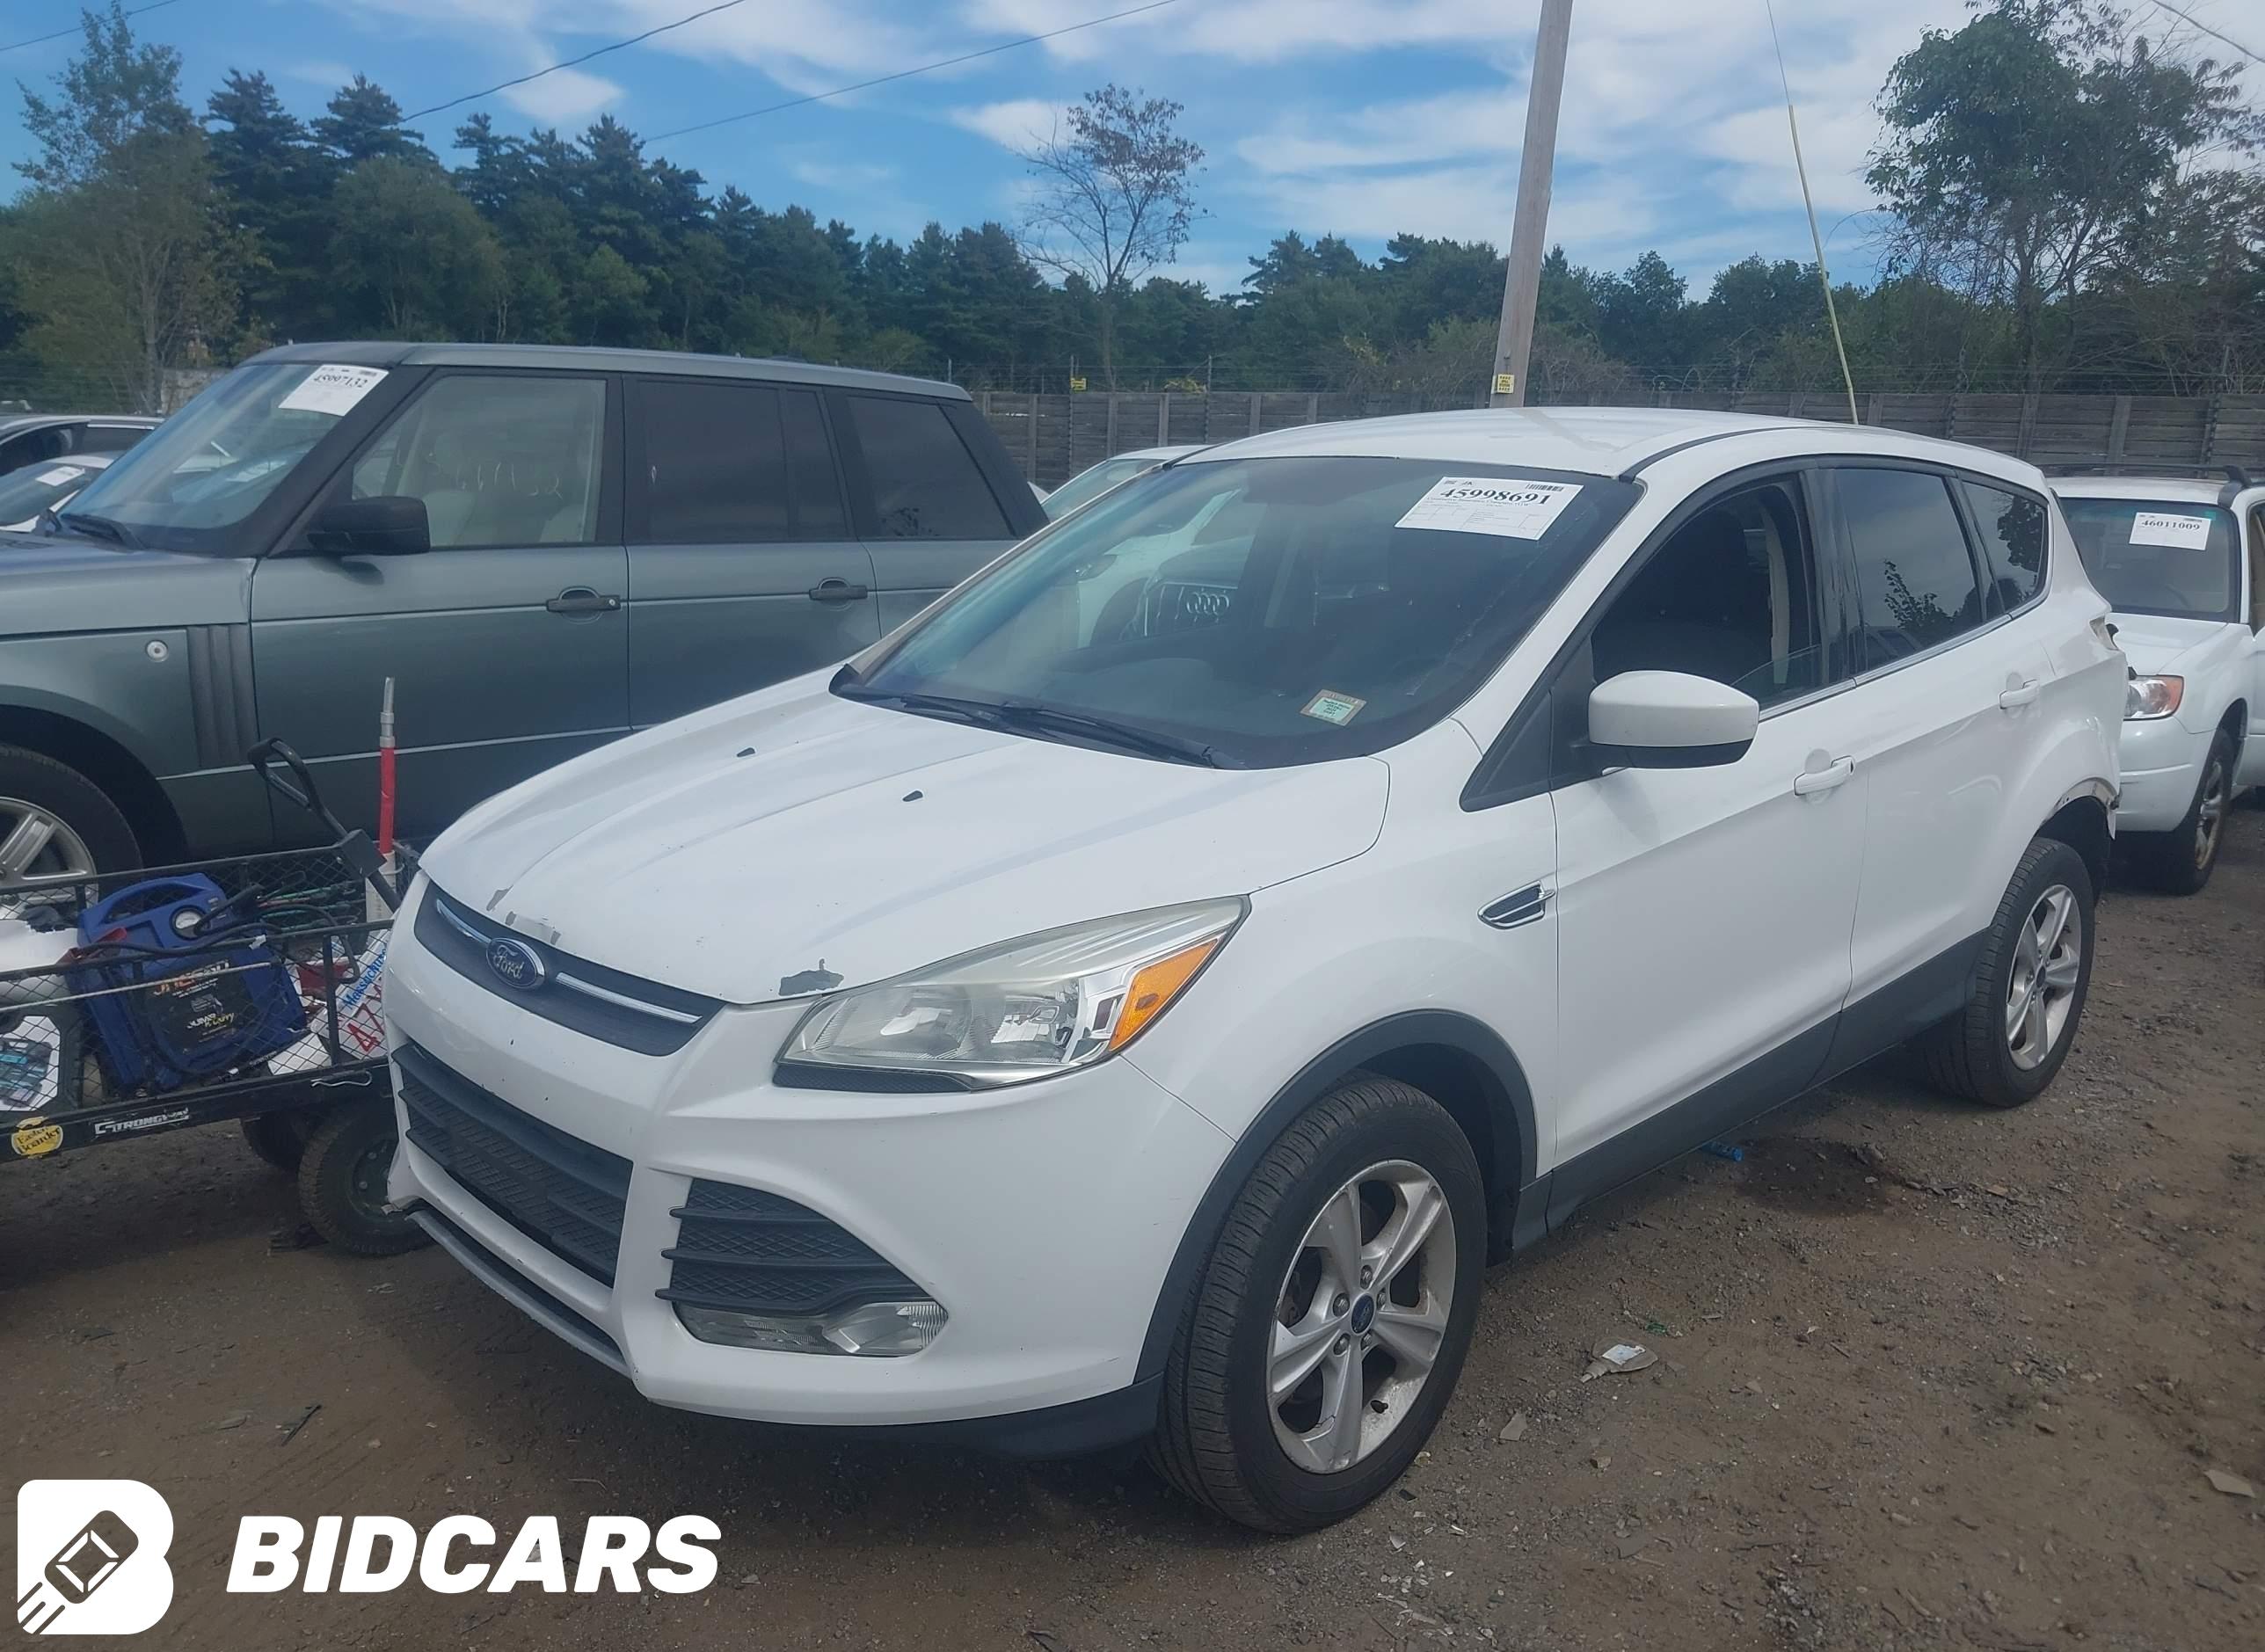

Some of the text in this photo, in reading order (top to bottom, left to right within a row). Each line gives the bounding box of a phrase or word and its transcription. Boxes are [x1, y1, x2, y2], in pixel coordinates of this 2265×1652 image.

[1440, 488, 1551, 505] 45998691
[2142, 520, 2201, 530] 46011009
[493, 945, 525, 979] Ford
